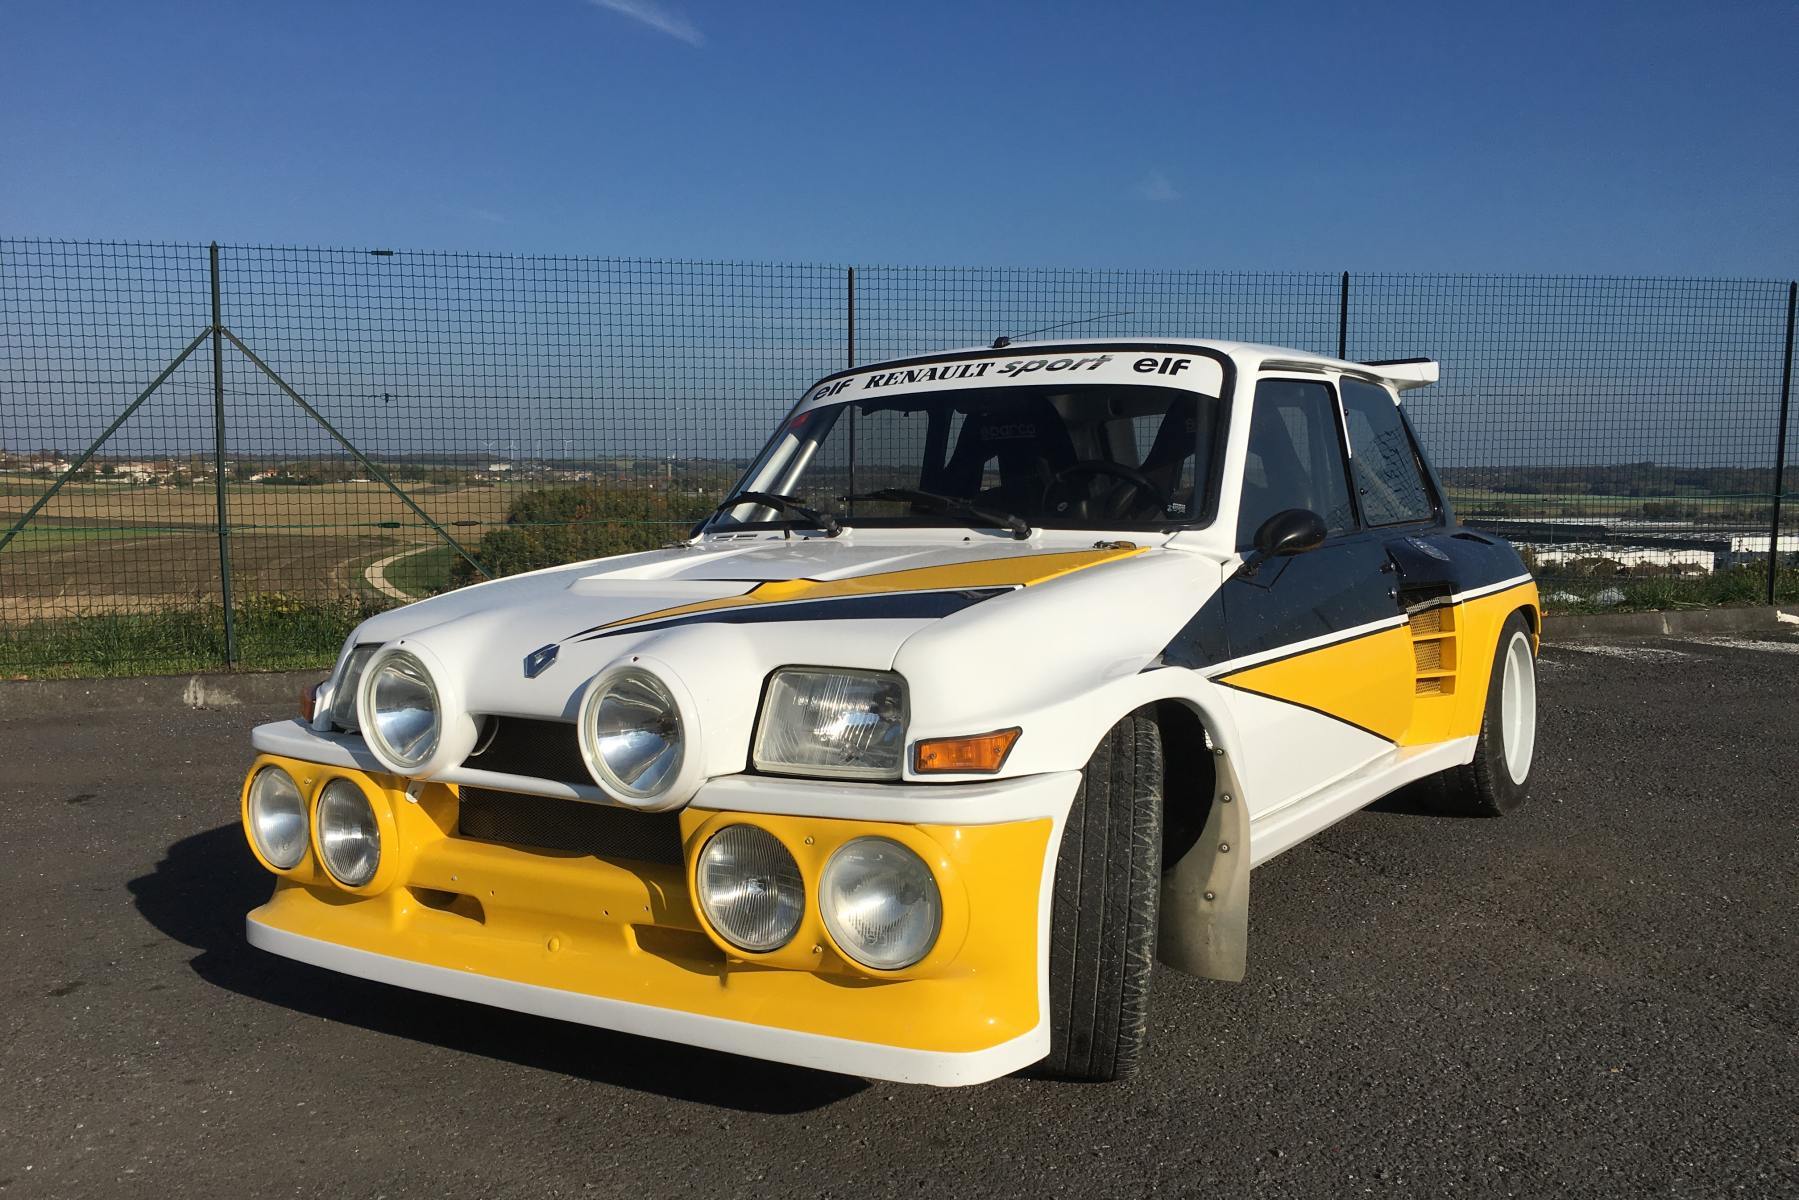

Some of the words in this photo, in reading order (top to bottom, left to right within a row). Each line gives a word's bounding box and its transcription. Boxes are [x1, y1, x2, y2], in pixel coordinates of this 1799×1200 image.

[813, 378, 854, 401] elf
[863, 362, 995, 389] RENAULT
[997, 355, 1114, 377] sport
[1133, 357, 1191, 376] elf
